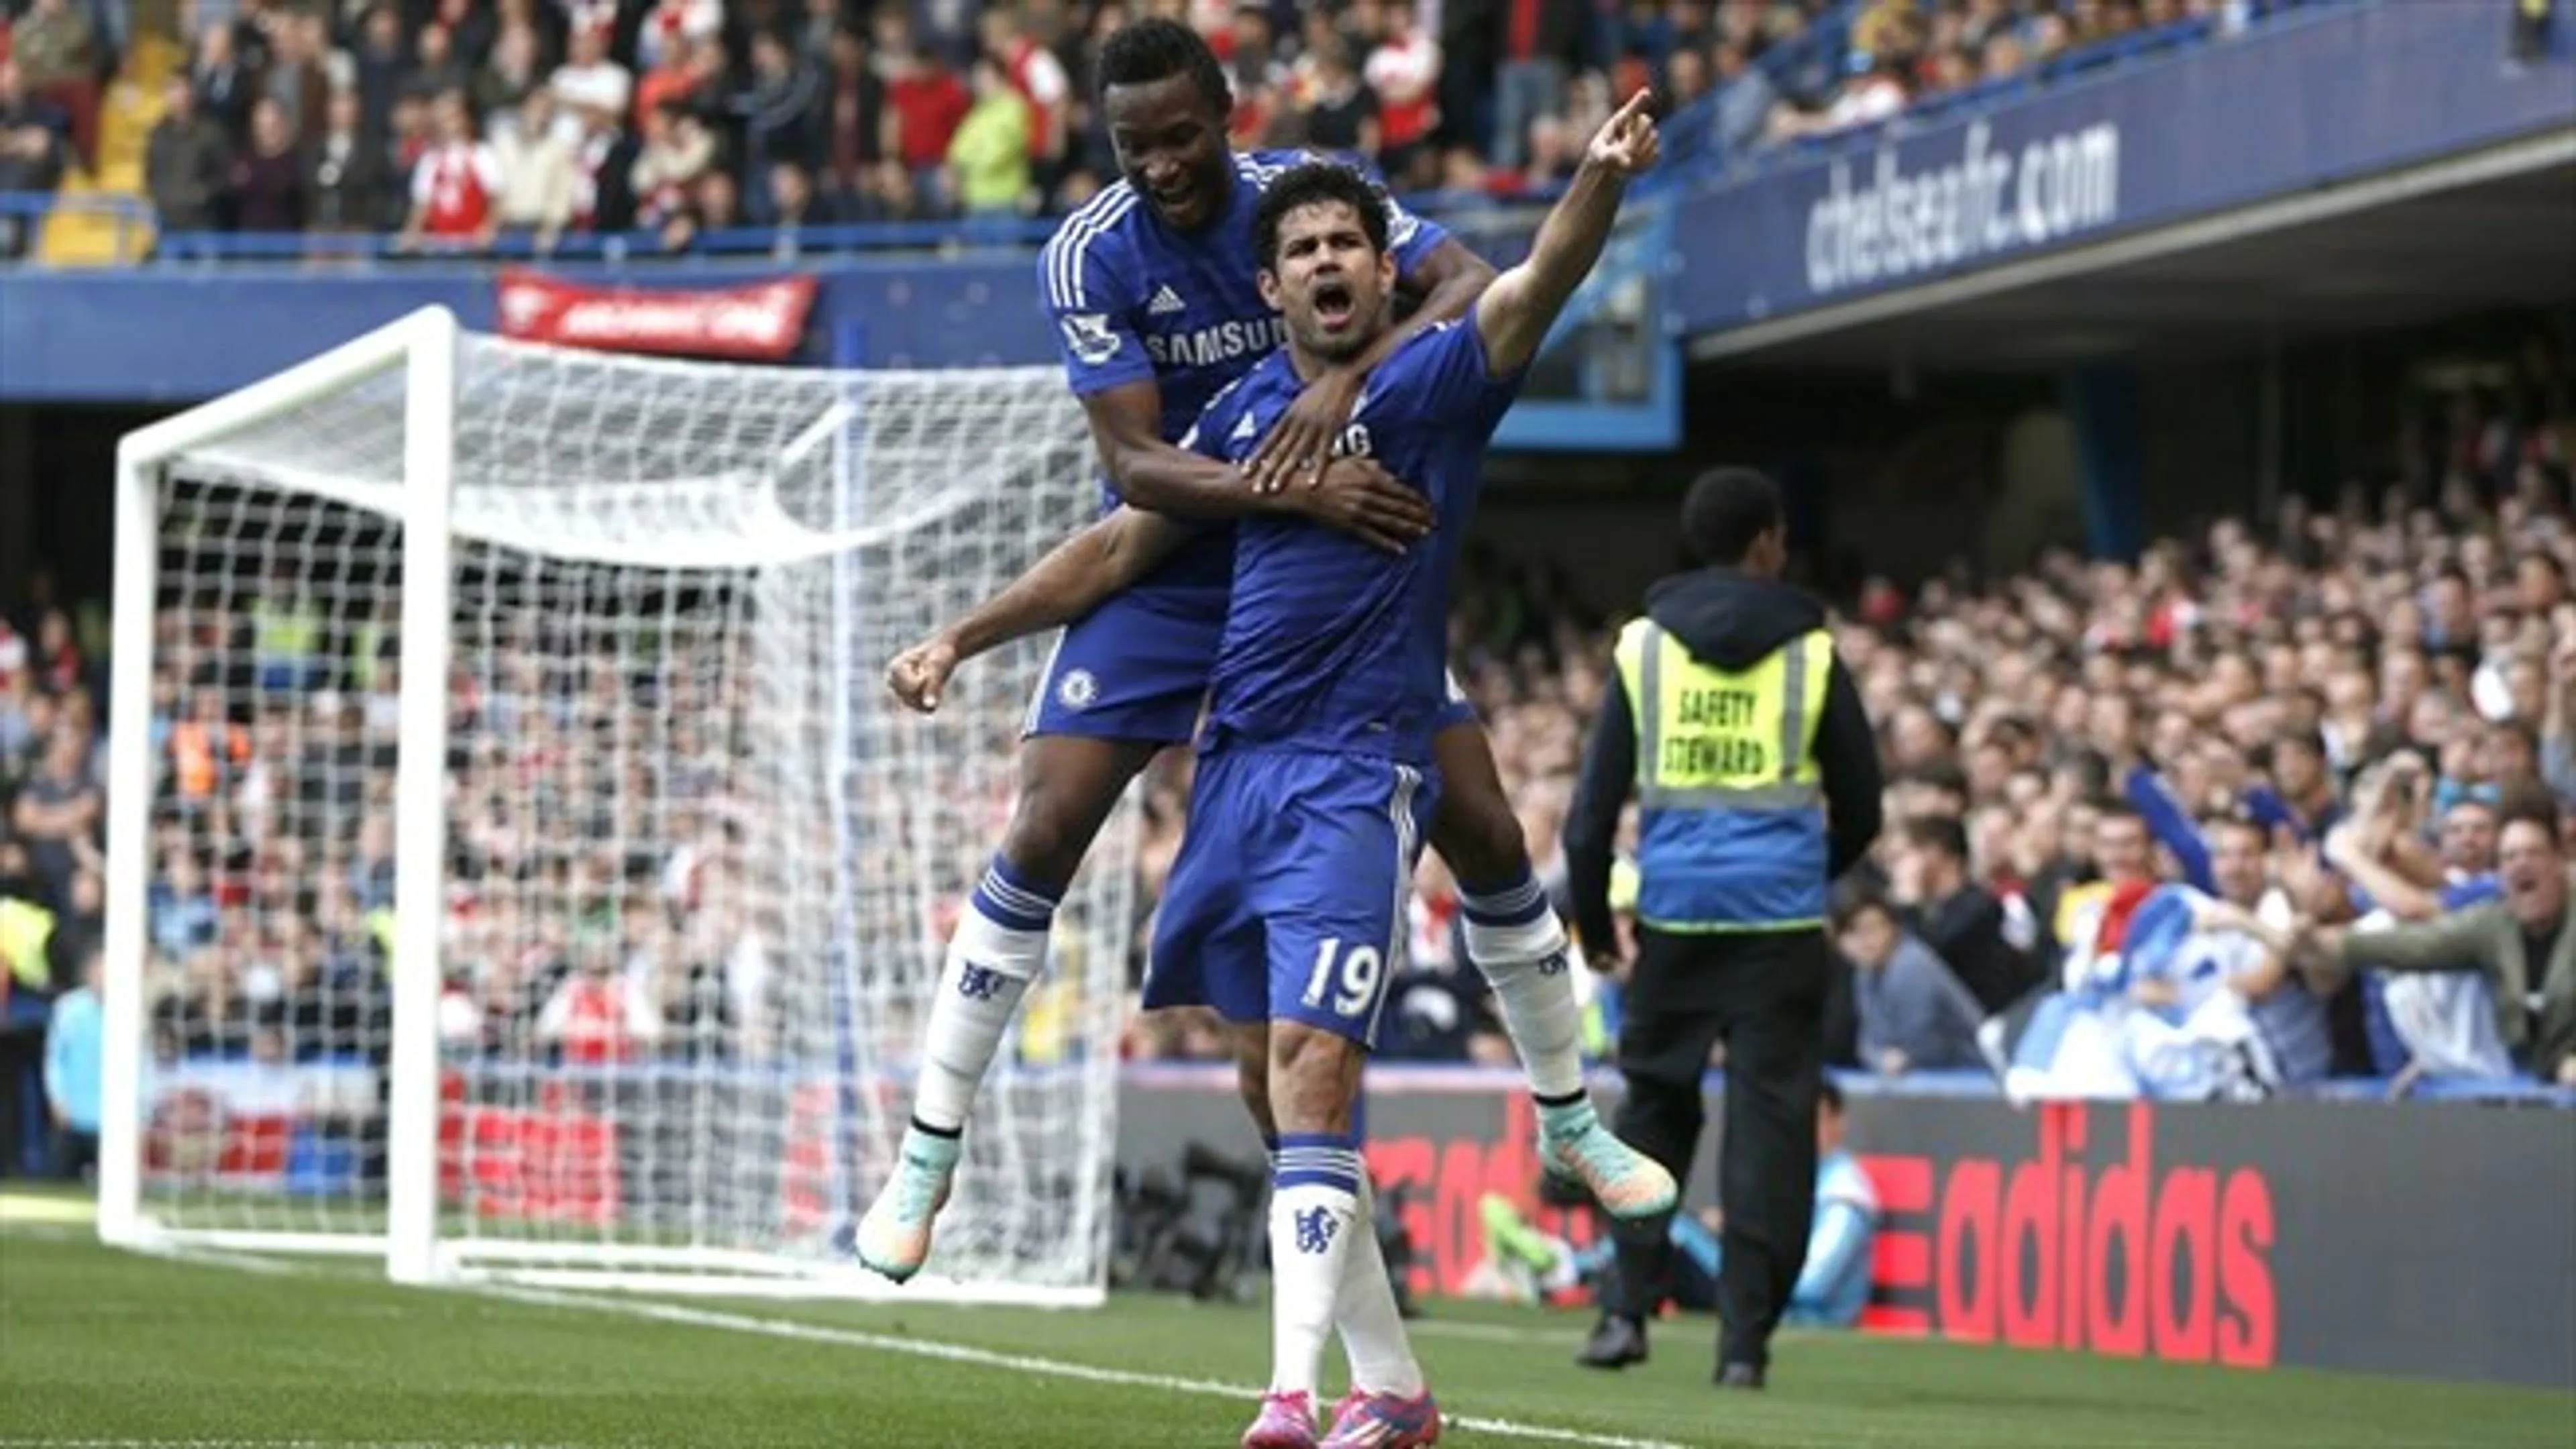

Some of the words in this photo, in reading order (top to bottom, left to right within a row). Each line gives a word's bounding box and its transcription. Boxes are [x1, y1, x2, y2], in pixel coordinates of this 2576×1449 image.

[1806, 119, 2119, 293] chelseafc.com
[1146, 317, 1291, 367] SAMSUN
[1678, 688, 1758, 727] SAFETY
[1664, 735, 1766, 775] STEWARD
[1300, 937, 1381, 1018] 19
[1937, 1100, 2277, 1368] adidas
